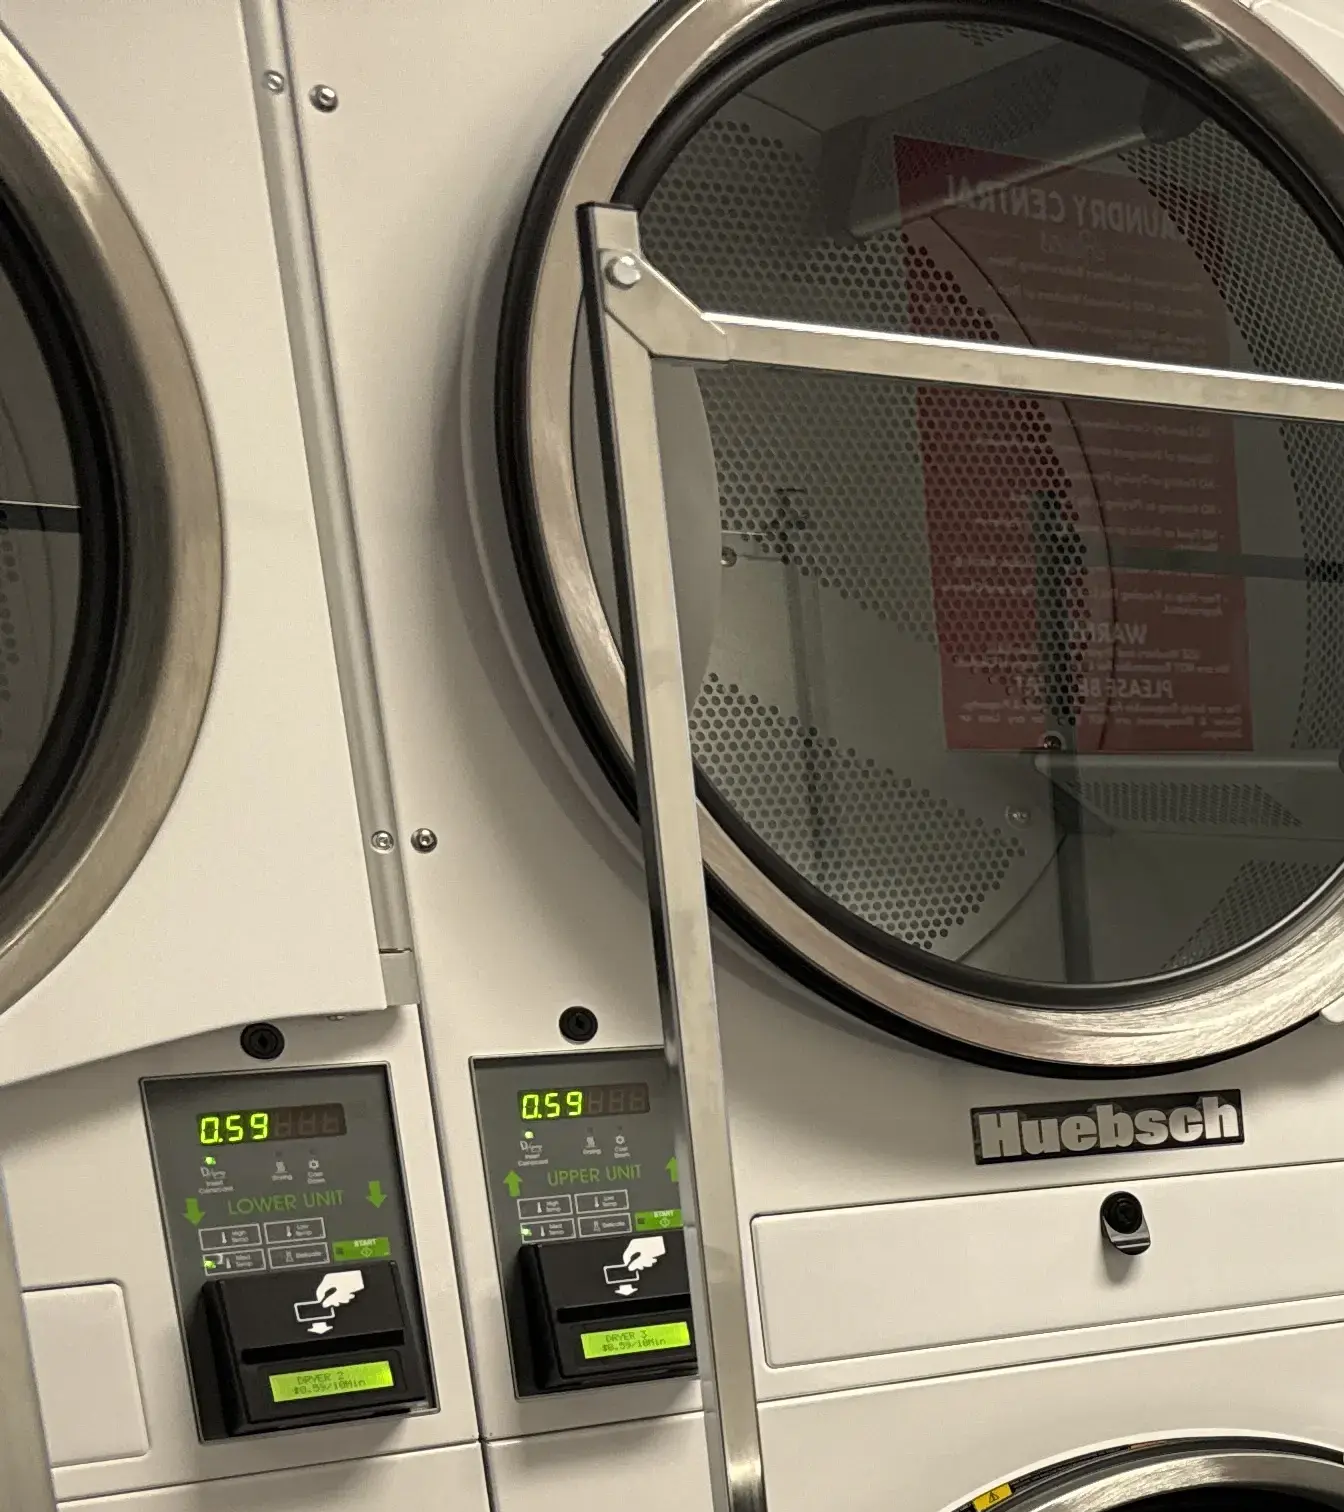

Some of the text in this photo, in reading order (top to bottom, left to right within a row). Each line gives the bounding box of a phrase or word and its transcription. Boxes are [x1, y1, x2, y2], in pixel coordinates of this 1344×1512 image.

[522, 1091, 583, 1119] 0.59
[200, 1112, 268, 1144] 0.59
[978, 1096, 1240, 1159] Huebsch
[547, 1164, 642, 1187] UPPER UNIT
[228, 1189, 344, 1215] LOWER UNIT
[605, 1329, 648, 1342] DRYER 3
[296, 1371, 345, 1385] DRYER 2
